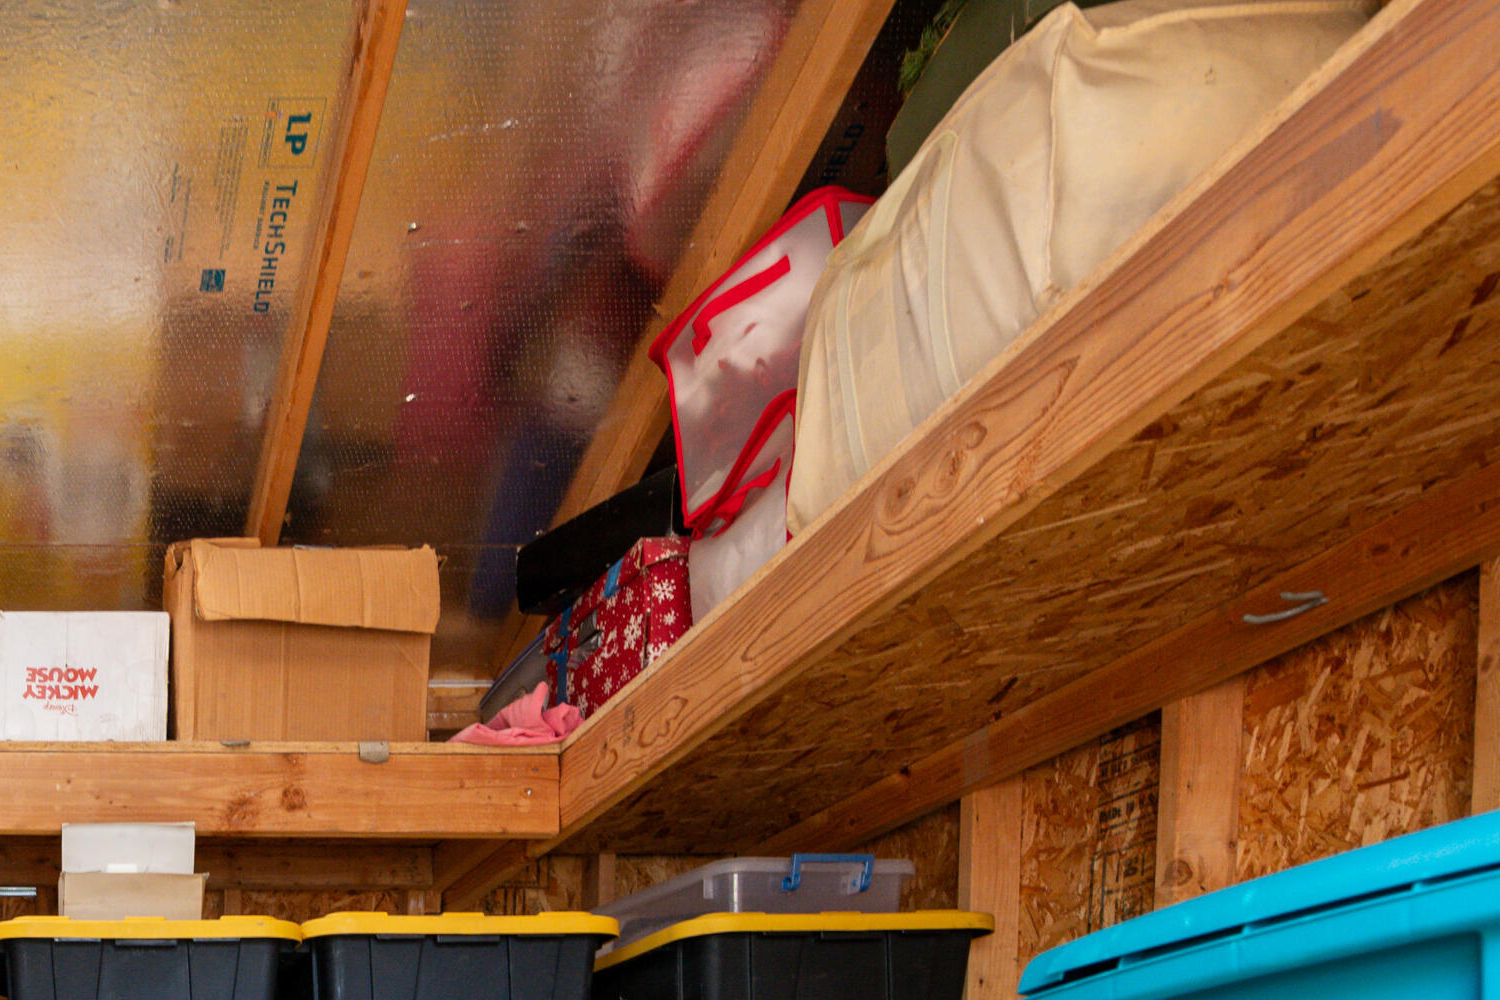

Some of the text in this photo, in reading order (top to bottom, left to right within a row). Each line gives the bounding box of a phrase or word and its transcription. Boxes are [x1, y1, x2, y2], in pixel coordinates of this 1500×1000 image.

[284, 112, 312, 155] LP
[26, 667, 97, 683] MOUSE
[23, 685, 99, 700] MICKEY
